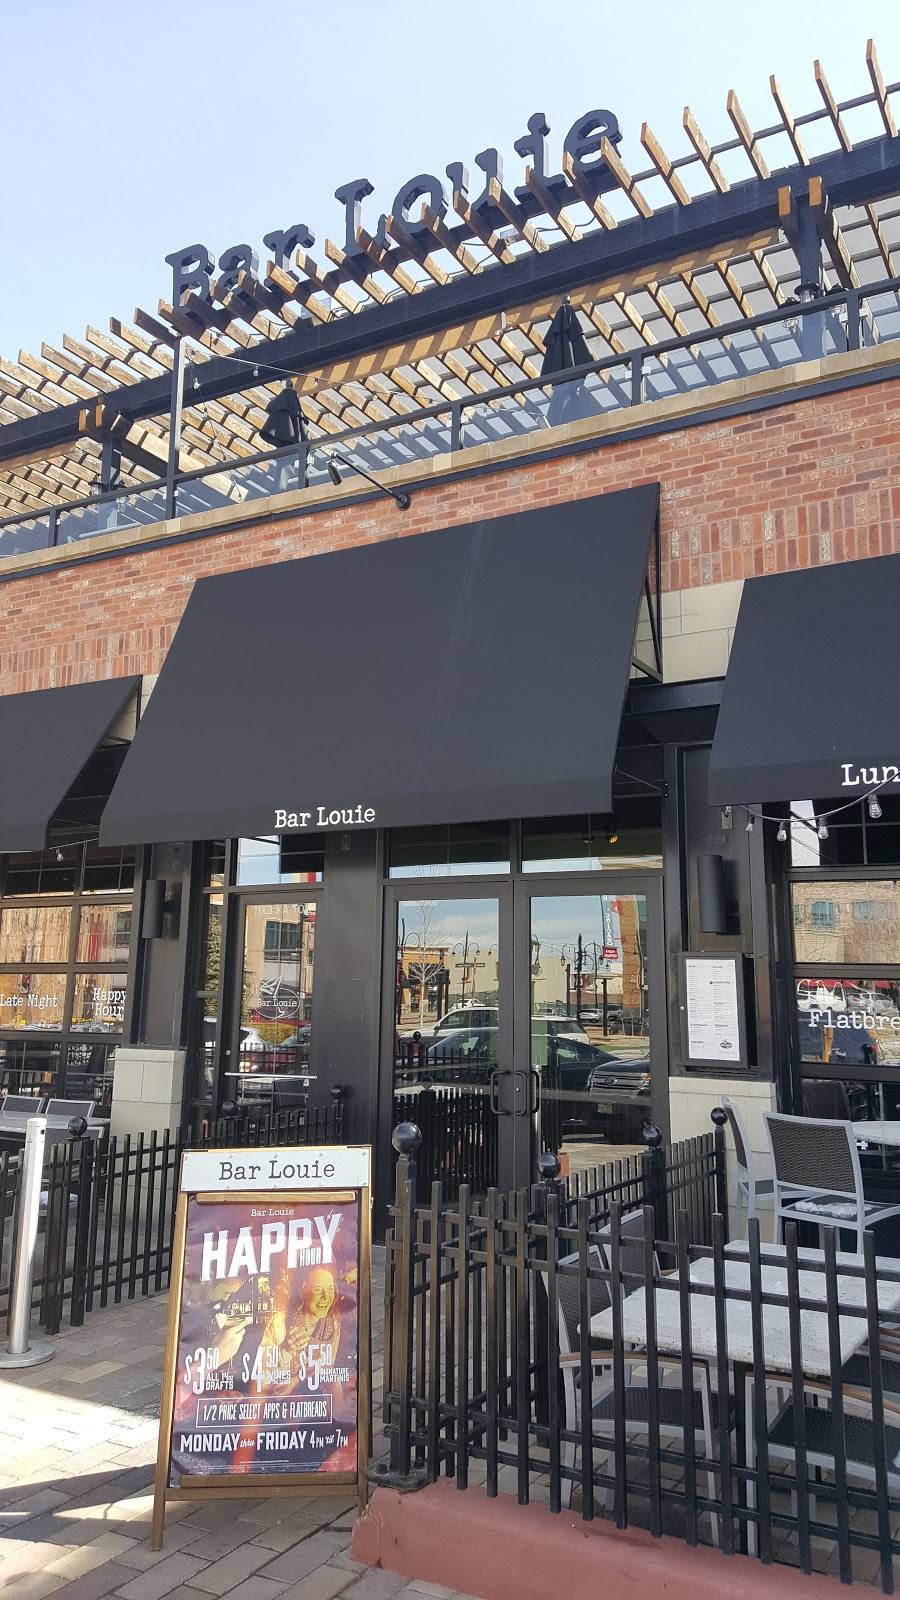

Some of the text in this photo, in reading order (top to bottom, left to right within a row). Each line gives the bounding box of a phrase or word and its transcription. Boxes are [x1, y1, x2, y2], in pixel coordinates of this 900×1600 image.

[164, 108, 624, 309] Bar Louie
[274, 804, 376, 828] Bar Louie
[0, 993, 58, 1010] Late Night
[92, 987, 127, 1004] Happy
[272, 998, 298, 1007] Louie
[94, 1002, 125, 1016] Hour
[808, 1008, 900, 1030] Flatbre
[218, 1159, 335, 1181] Bar Louie
[251, 1208, 295, 1217] Bar Louie
[201, 1213, 343, 1282] HAPPY
[299, 1246, 322, 1267] HOUR
[205, 1381, 234, 1391] DRAFTS
[206, 1372, 220, 1382] ALL
[320, 1374, 350, 1383] MARTINIS
[203, 1400, 328, 1421] 1/2 PRICE SELECT APPS & FLATBREADS
[180, 1432, 241, 1453] MONDAY
[256, 1430, 308, 1451] FRIDAY
